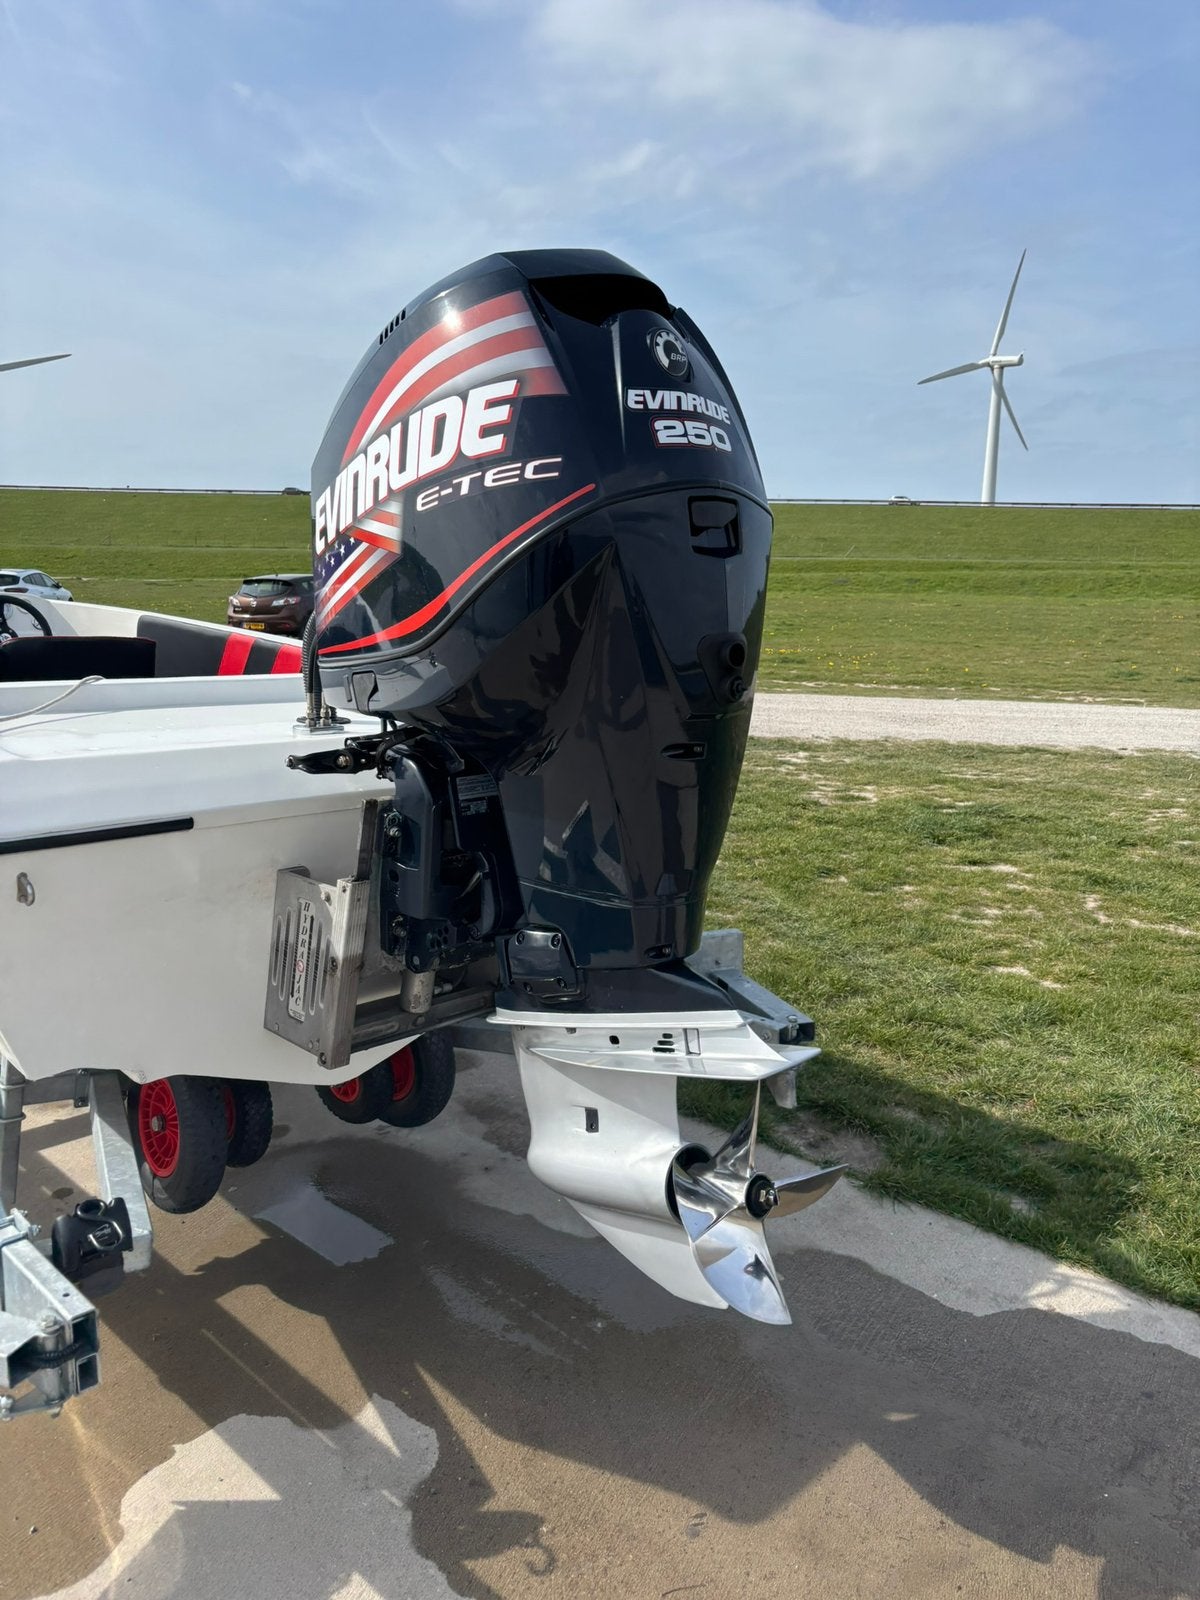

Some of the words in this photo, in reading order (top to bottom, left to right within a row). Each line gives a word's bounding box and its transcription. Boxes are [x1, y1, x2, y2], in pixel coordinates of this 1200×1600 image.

[670, 352, 687, 362] BRP
[627, 389, 731, 425] EVINRUDE
[653, 419, 732, 452] 250
[315, 379, 520, 556] EVINRUDE
[416, 457, 562, 512] E-TEC
